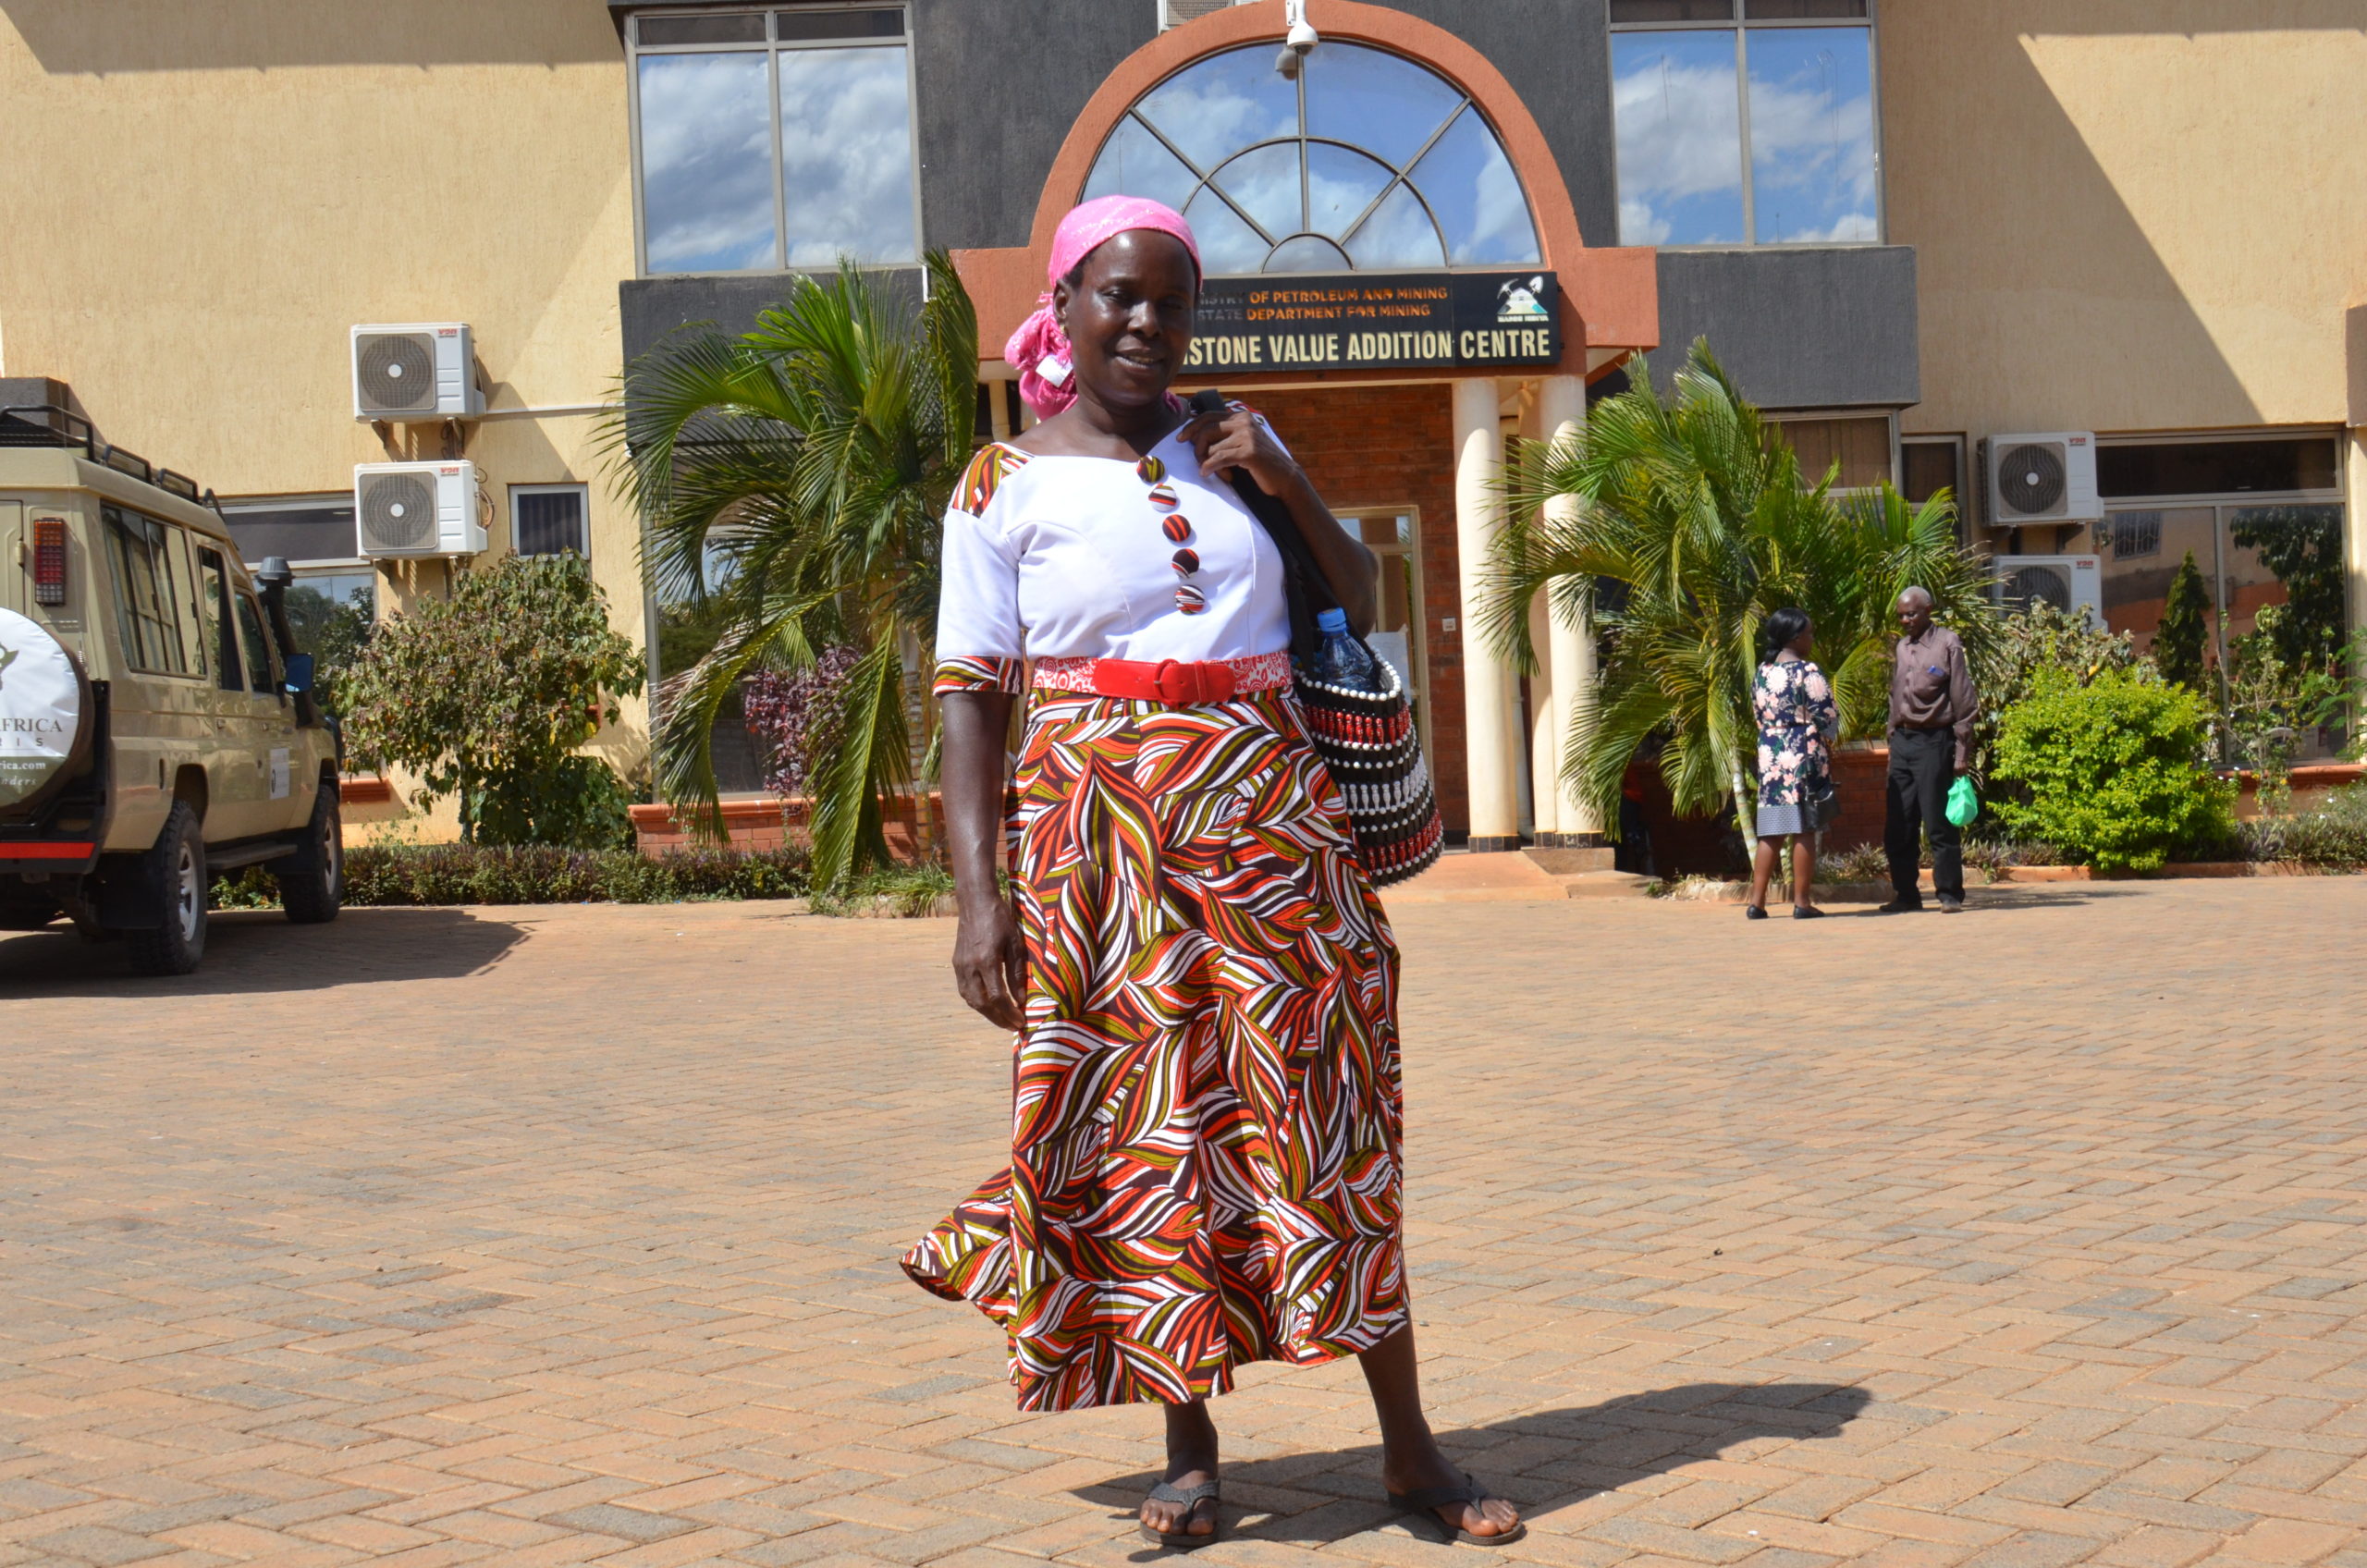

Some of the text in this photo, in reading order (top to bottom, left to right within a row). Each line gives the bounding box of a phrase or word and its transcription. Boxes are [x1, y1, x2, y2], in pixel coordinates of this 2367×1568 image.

[1249, 290, 1269, 303] OF
[1272, 288, 1358, 303] PETROLEUM
[1397, 287, 1448, 300] MINING
[1246, 307, 1343, 321] DEPARTMENT
[1346, 306, 1376, 318] FOR
[1380, 303, 1431, 317] MINING
[1269, 332, 1340, 363] VALUE
[1346, 330, 1453, 361] ADDITION
[1460, 328, 1551, 359] CENTRE
[0, 717, 63, 733] FRICA
